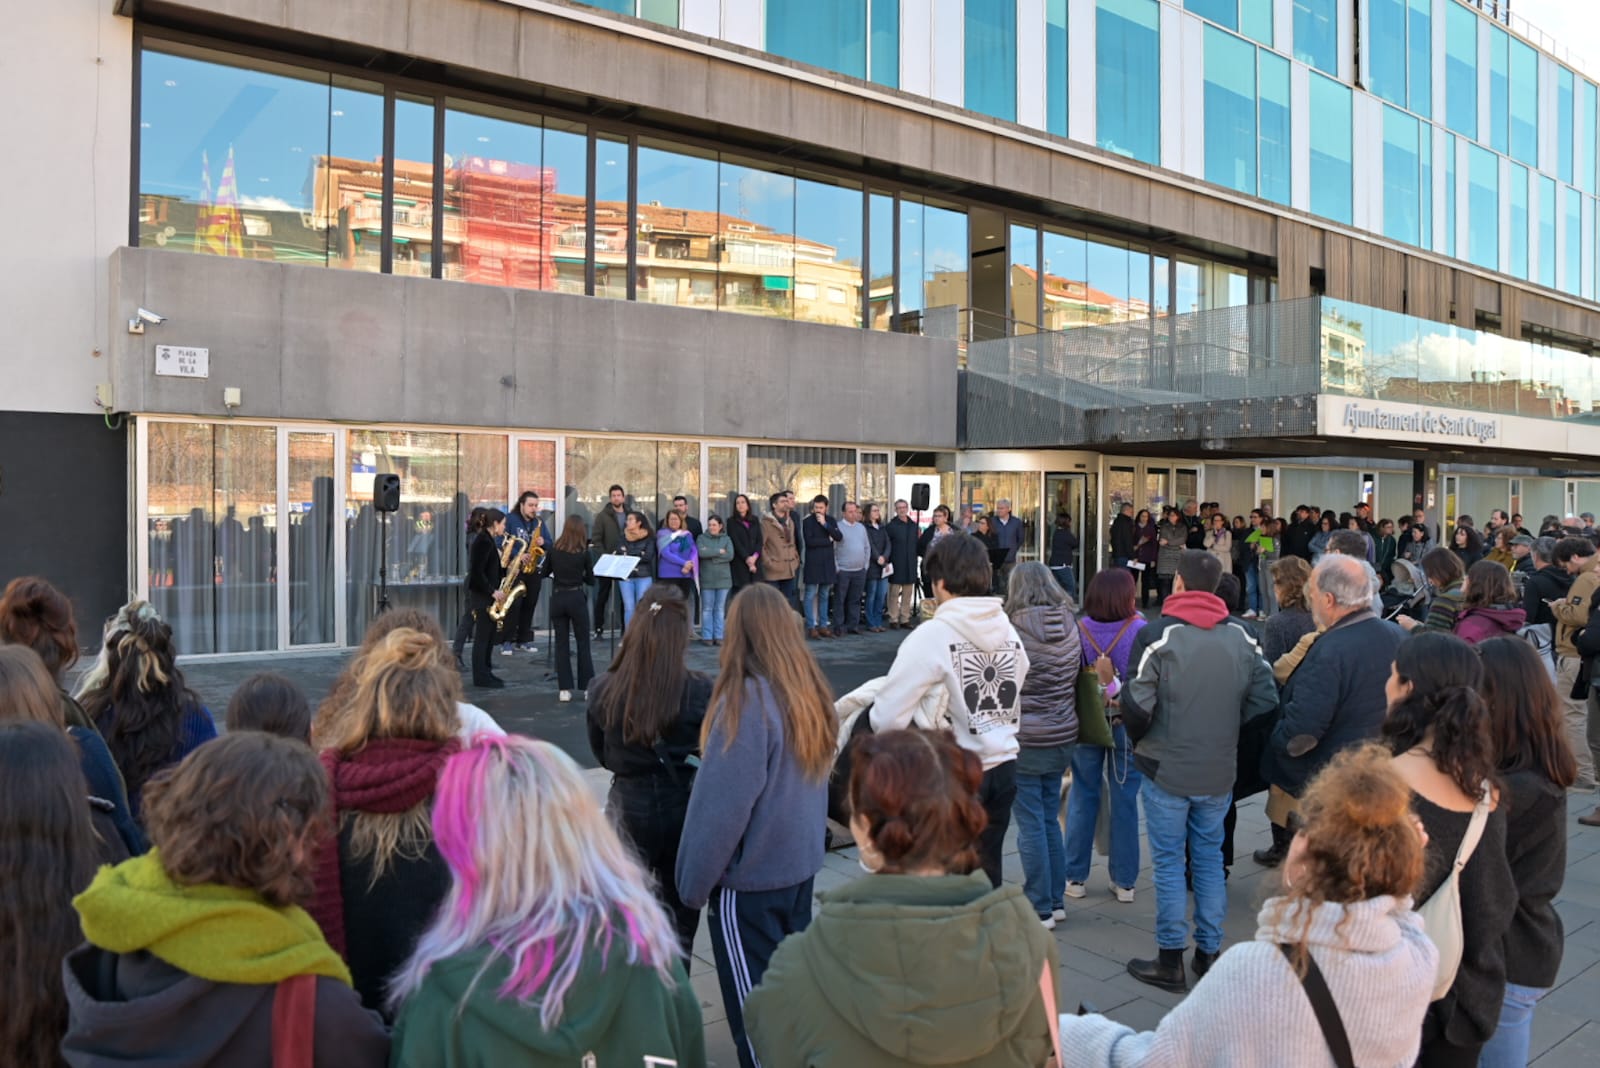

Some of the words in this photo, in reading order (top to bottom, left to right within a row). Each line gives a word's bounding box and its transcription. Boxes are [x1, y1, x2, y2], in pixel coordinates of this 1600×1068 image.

[179, 366, 195, 374] VILA
[1343, 403, 1420, 433] Ajuntament
[1422, 411, 1438, 434] de
[1439, 413, 1465, 436] Sant
[1466, 416, 1496, 443] Cugat
